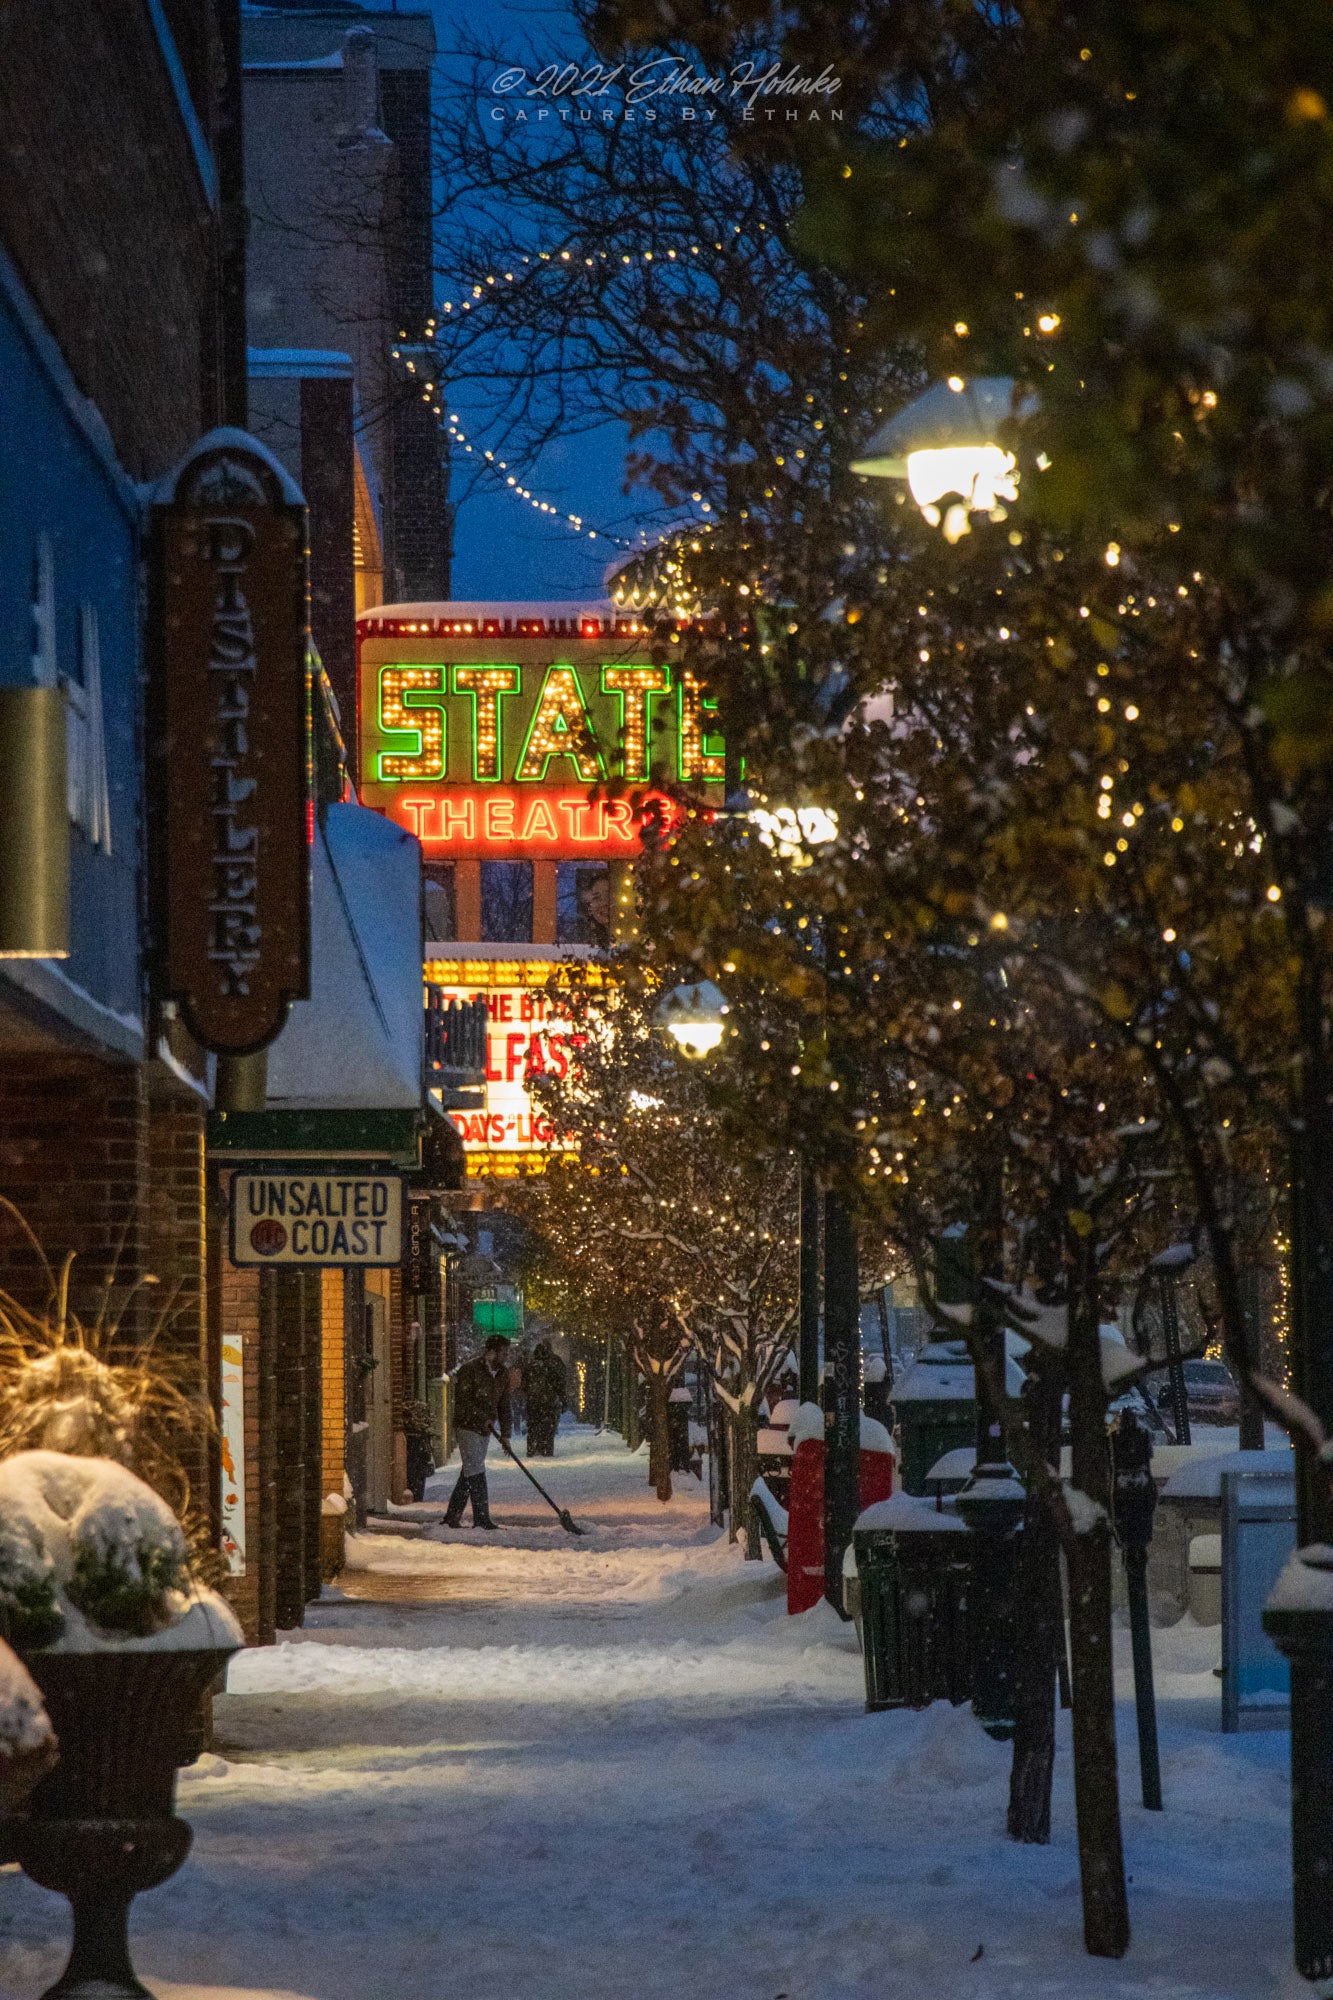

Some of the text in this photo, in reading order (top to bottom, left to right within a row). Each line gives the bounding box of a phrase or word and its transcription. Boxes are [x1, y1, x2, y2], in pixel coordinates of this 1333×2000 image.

[203, 516, 262, 996] DISTILLERY
[377, 664, 745, 782] STATE
[248, 1181, 388, 1217] UNSALTED
[292, 1220, 387, 1256] COAST
